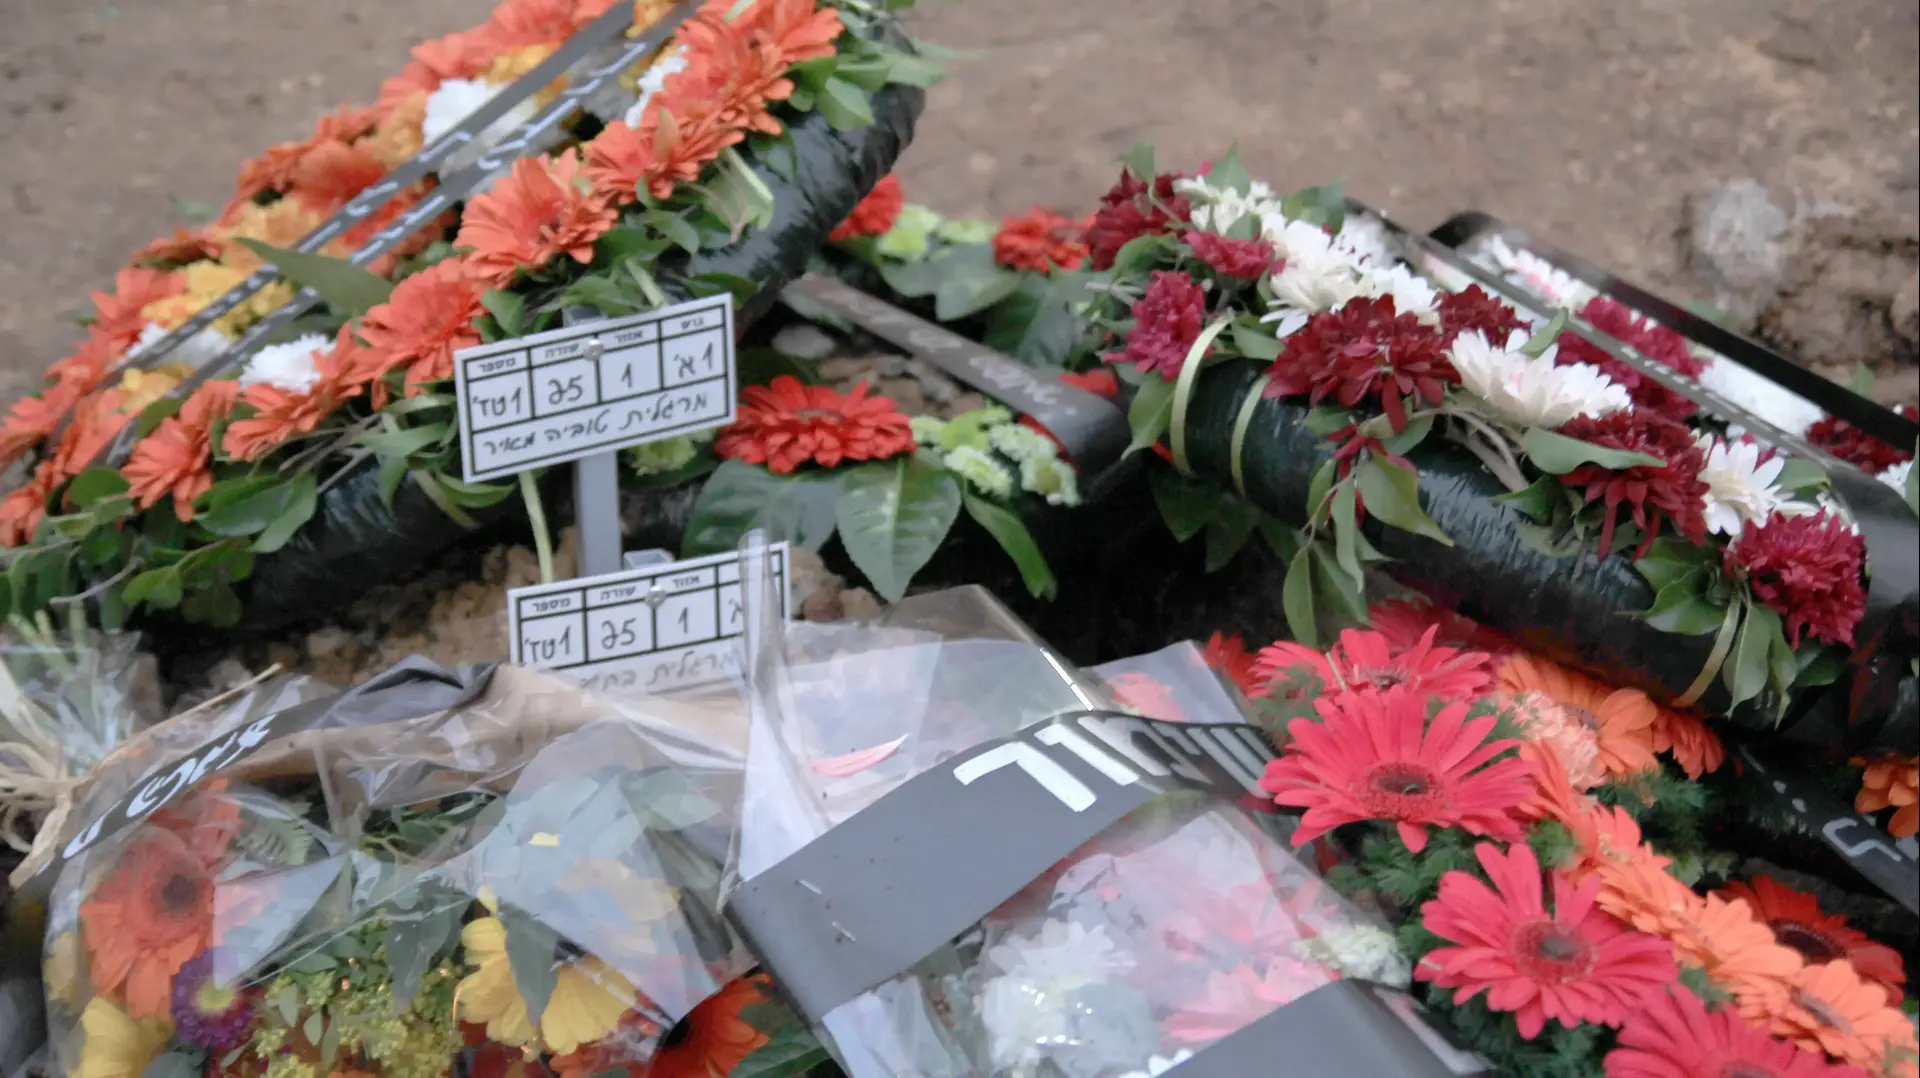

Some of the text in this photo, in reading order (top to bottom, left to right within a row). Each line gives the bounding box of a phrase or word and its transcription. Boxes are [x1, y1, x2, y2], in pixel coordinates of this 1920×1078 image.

[545, 343, 580, 359] שורה
[478, 357, 516, 373] מספר
[621, 362, 633, 388] 1
[547, 375, 584, 405] 25
[483, 392, 707, 455] מרגלית טוביה מאיר
[532, 597, 571, 613] מספר
[600, 586, 636, 601] שורה
[677, 606, 688, 634] 1
[601, 618, 636, 650] 25
